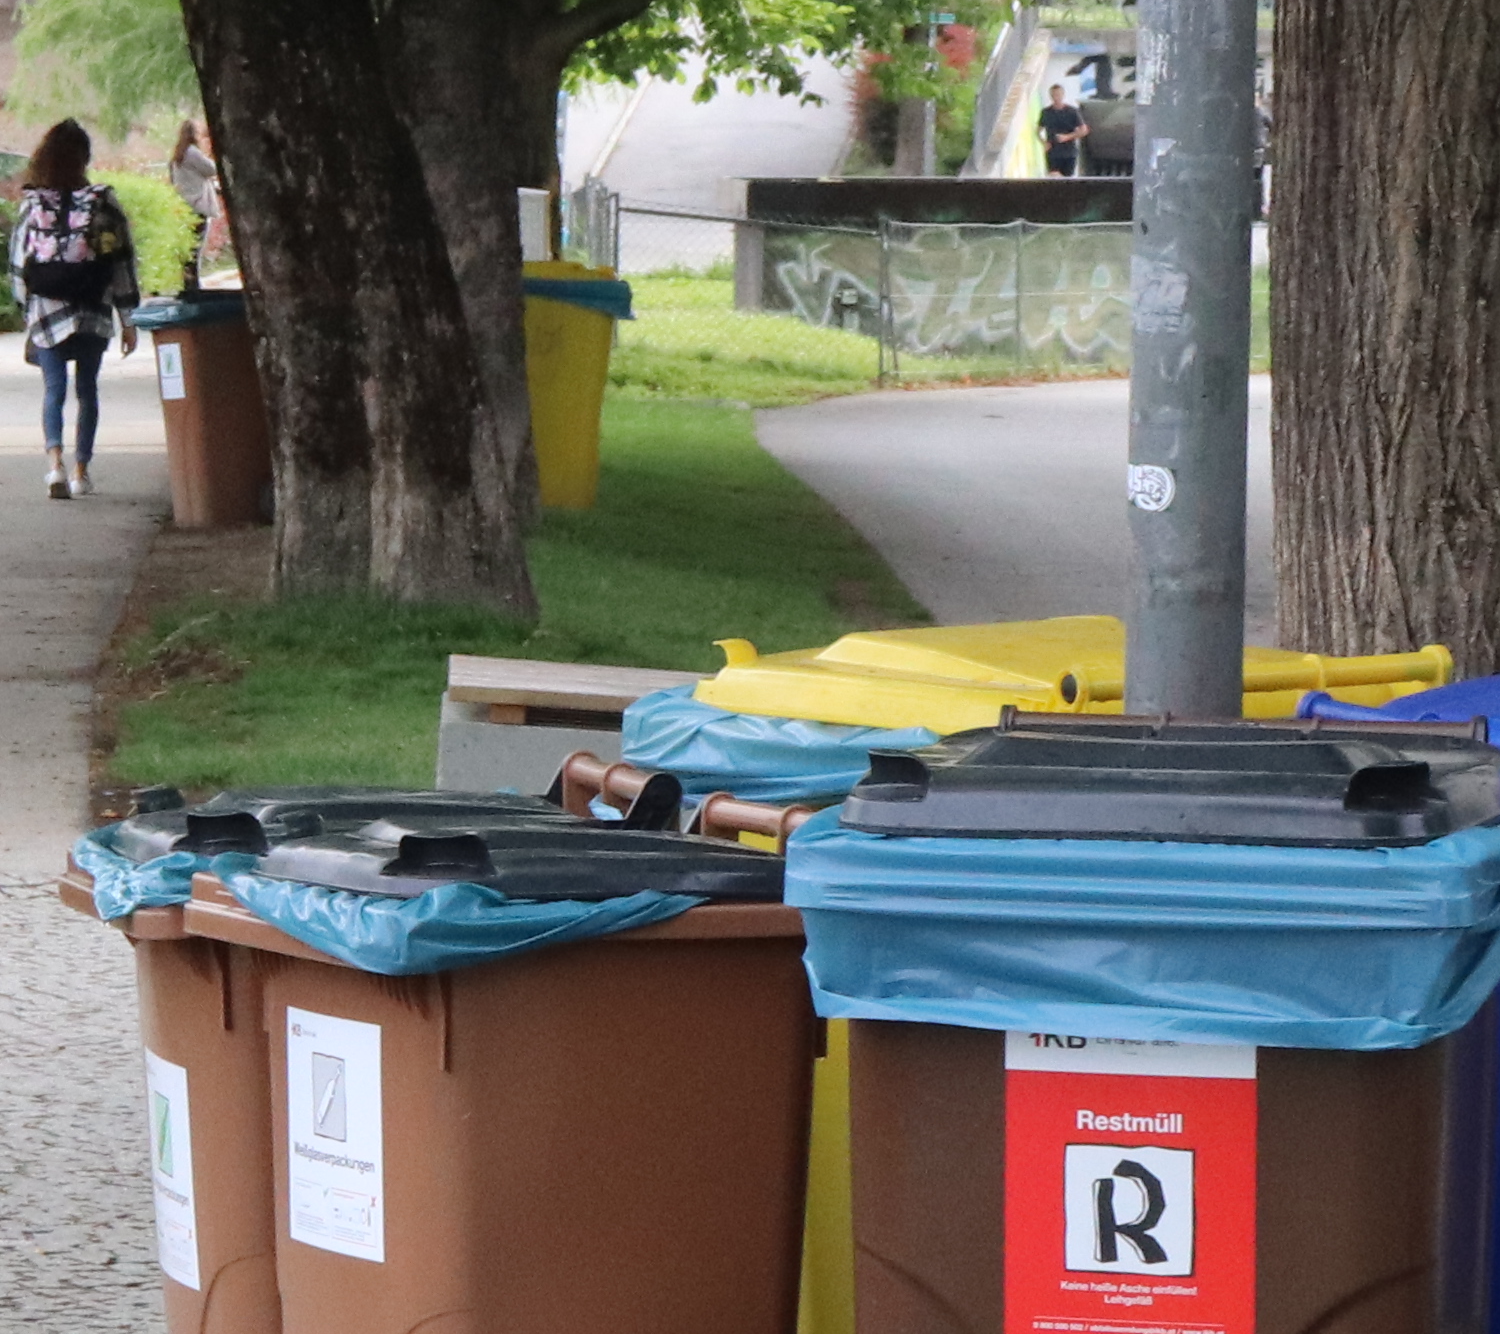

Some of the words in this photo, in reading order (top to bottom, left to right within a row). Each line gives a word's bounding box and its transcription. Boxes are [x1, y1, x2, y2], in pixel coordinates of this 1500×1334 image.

[1076, 1109, 1184, 1133] Restmüll
[1092, 1158, 1168, 1265] R
[1060, 1280, 1089, 1291] Keine
[1119, 1283, 1150, 1294] Asche
